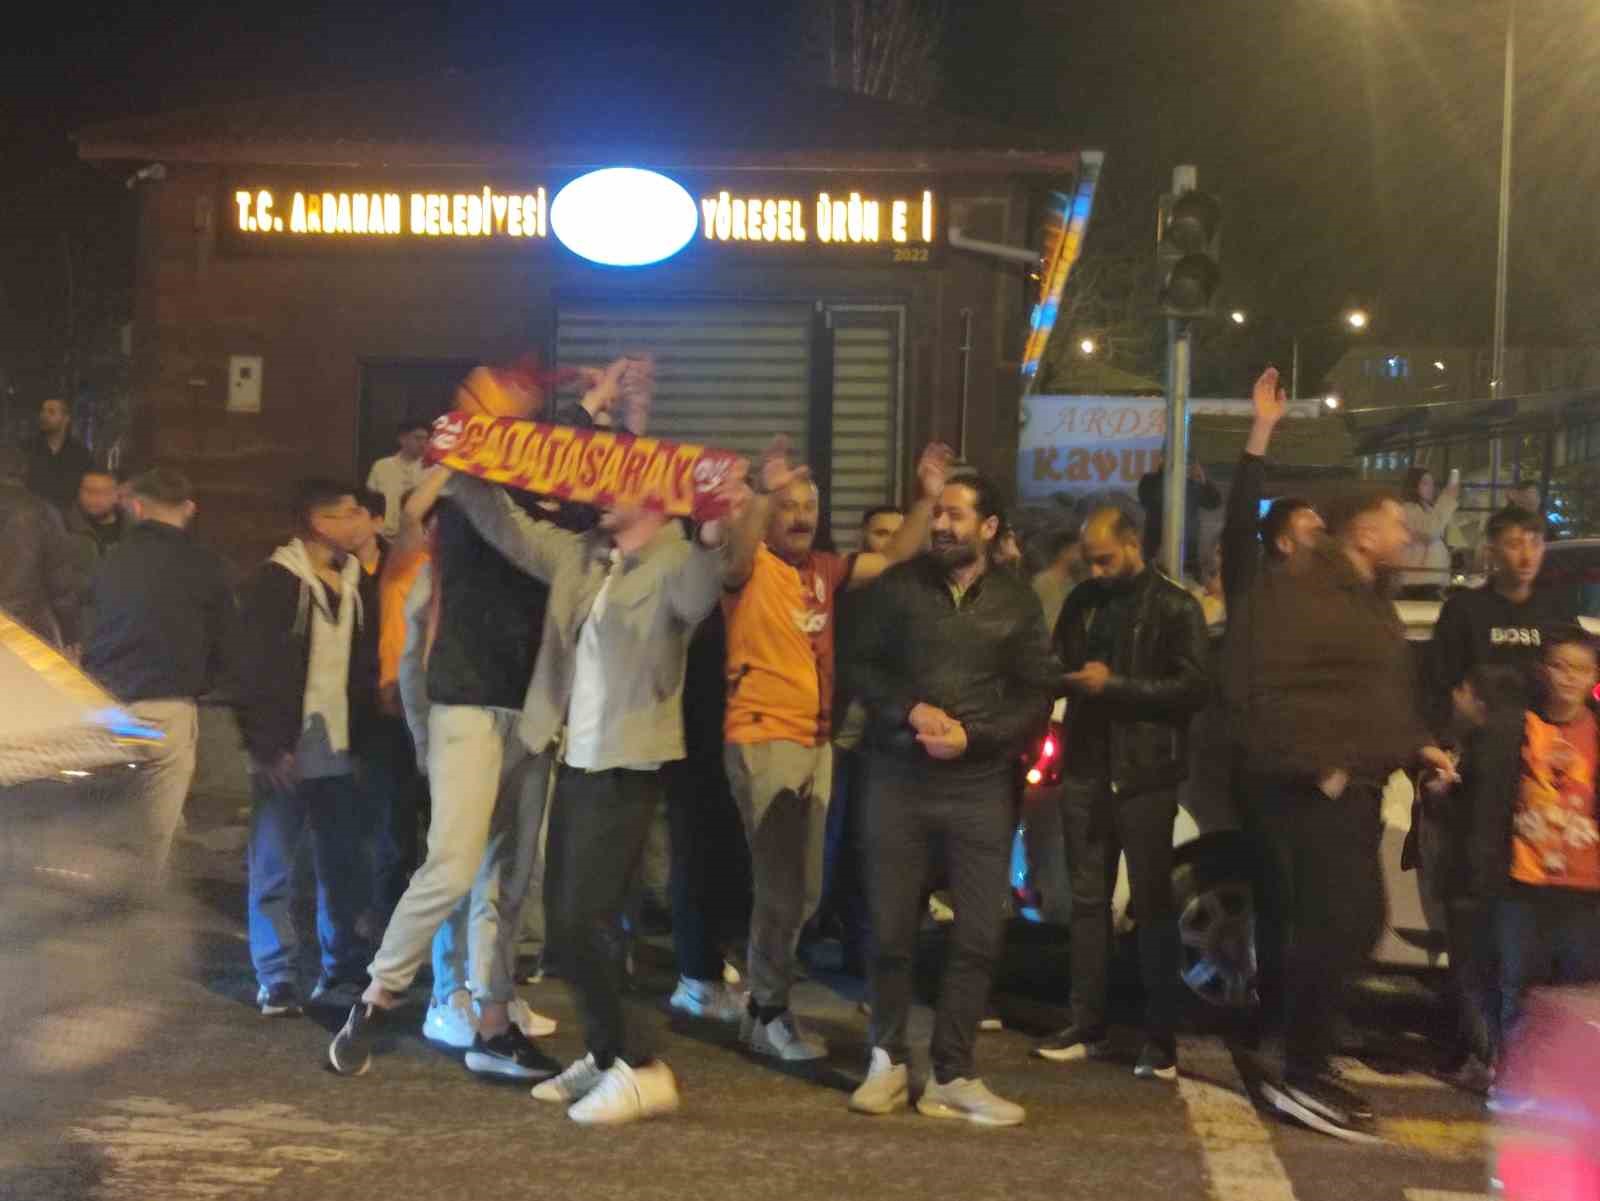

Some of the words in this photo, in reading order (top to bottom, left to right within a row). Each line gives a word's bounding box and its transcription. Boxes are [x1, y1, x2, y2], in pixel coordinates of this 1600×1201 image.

[235, 190, 283, 232] T.C.
[410, 185, 546, 237] BELEDİYESİ
[702, 191, 807, 242] YÖRESEL
[816, 192, 879, 243] ÜRÜN
[457, 415, 697, 505] GALATASARAY
[1490, 627, 1540, 647] BOSS
